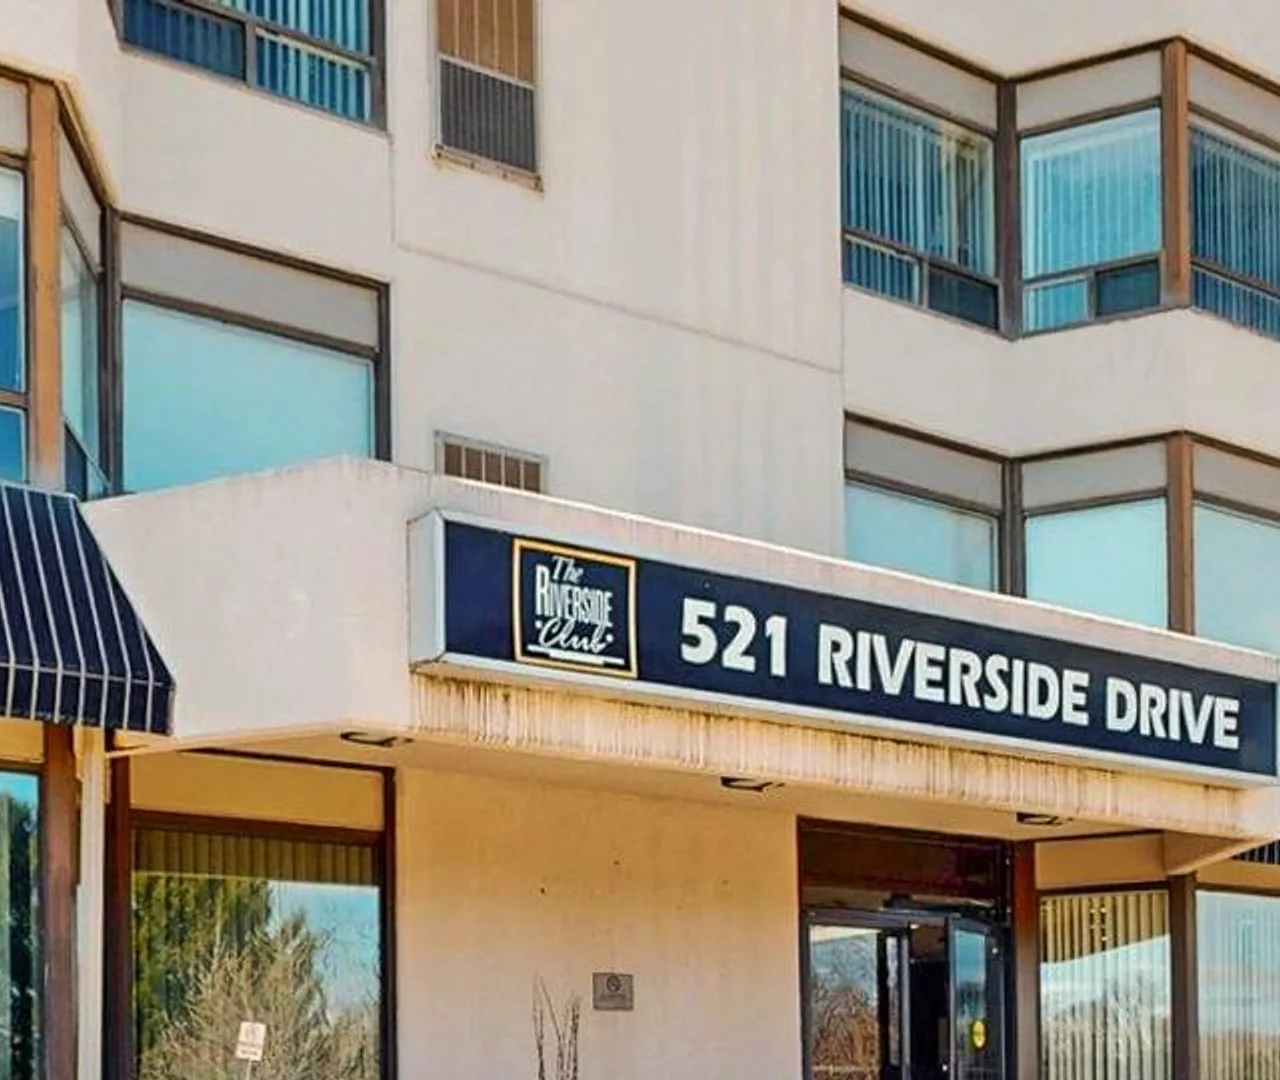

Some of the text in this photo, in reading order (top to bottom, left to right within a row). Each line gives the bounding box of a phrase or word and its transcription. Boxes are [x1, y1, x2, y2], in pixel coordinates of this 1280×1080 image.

[551, 555, 584, 583] The
[538, 616, 608, 654] Club
[680, 597, 1240, 750] 521 RIVERSIDE DRIVE
